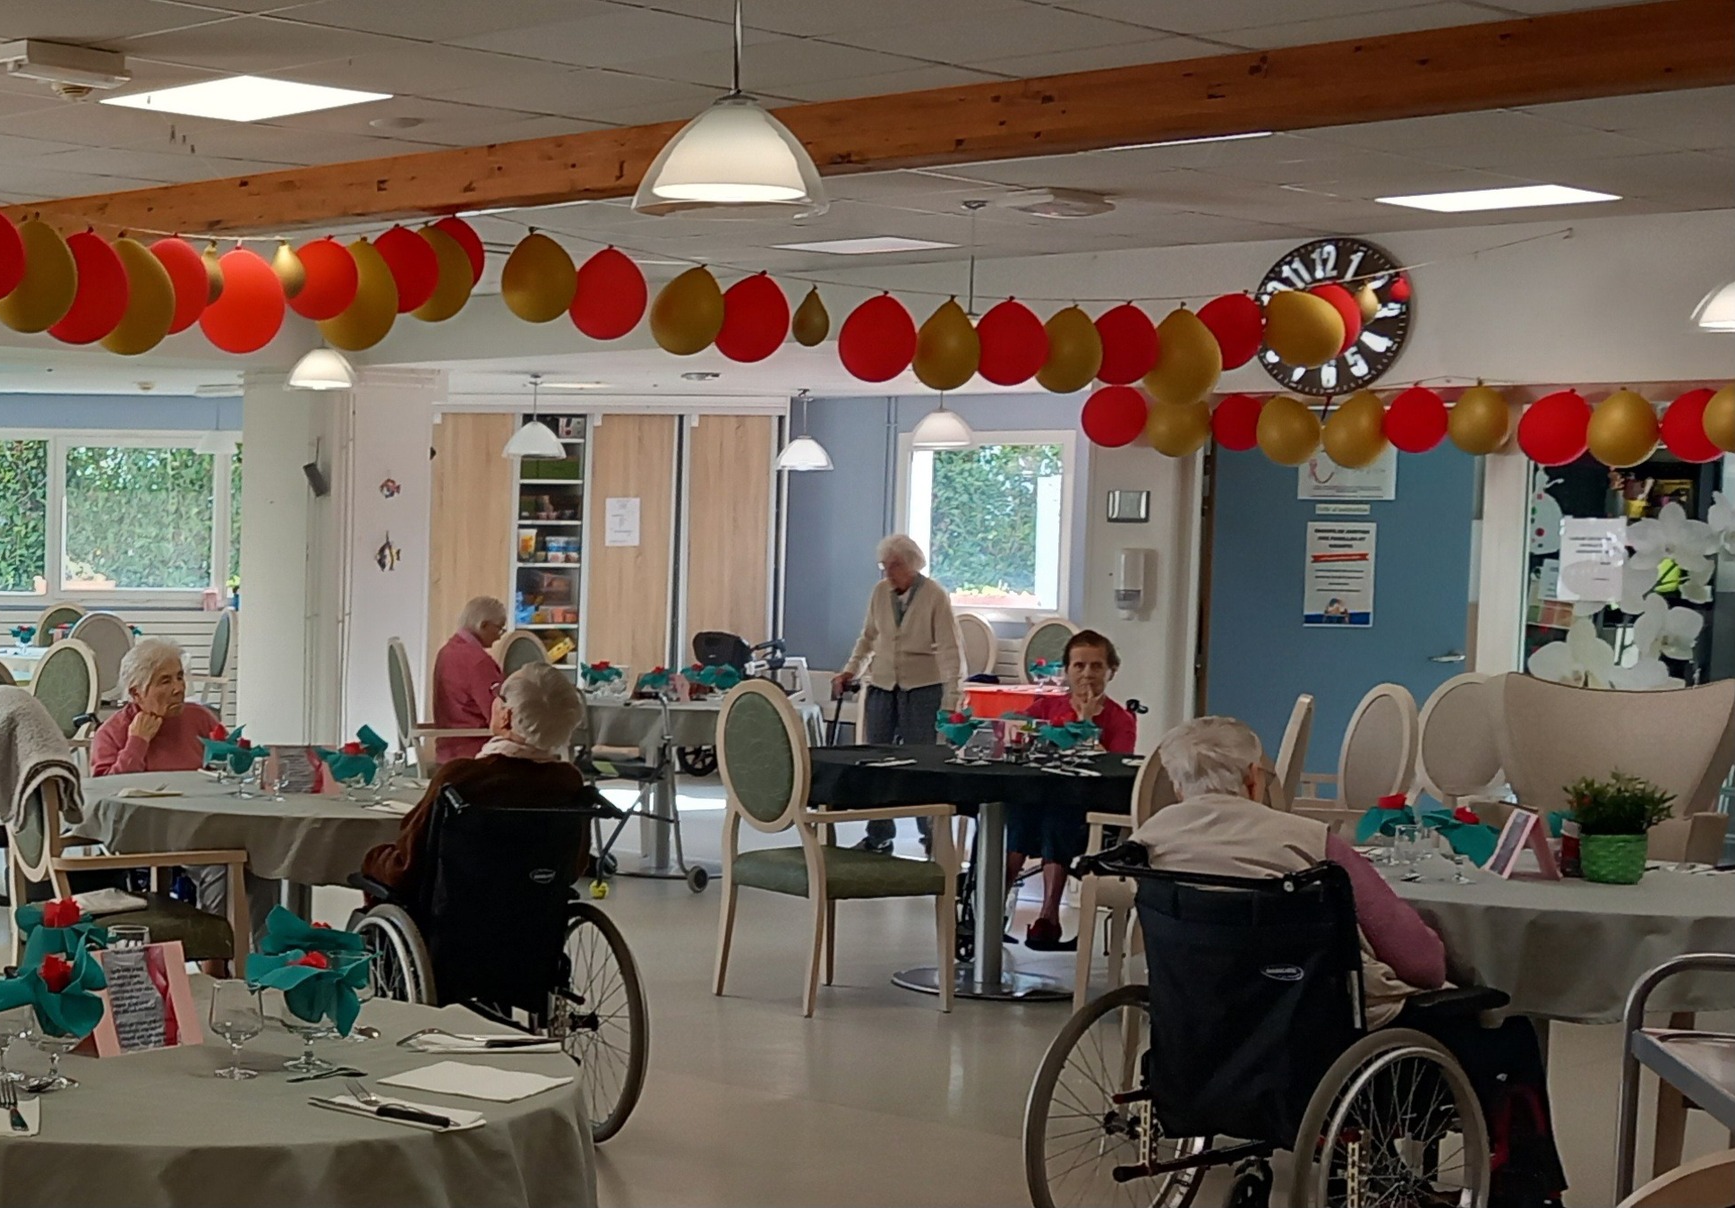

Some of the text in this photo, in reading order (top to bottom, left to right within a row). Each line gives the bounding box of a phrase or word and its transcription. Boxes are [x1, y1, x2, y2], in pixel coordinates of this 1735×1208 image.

[1282, 257, 1312, 289] 11
[1311, 244, 1338, 279] 12
[1345, 252, 1364, 280] 1
[1320, 359, 1338, 388] 6
[1344, 346, 1369, 377] 5
